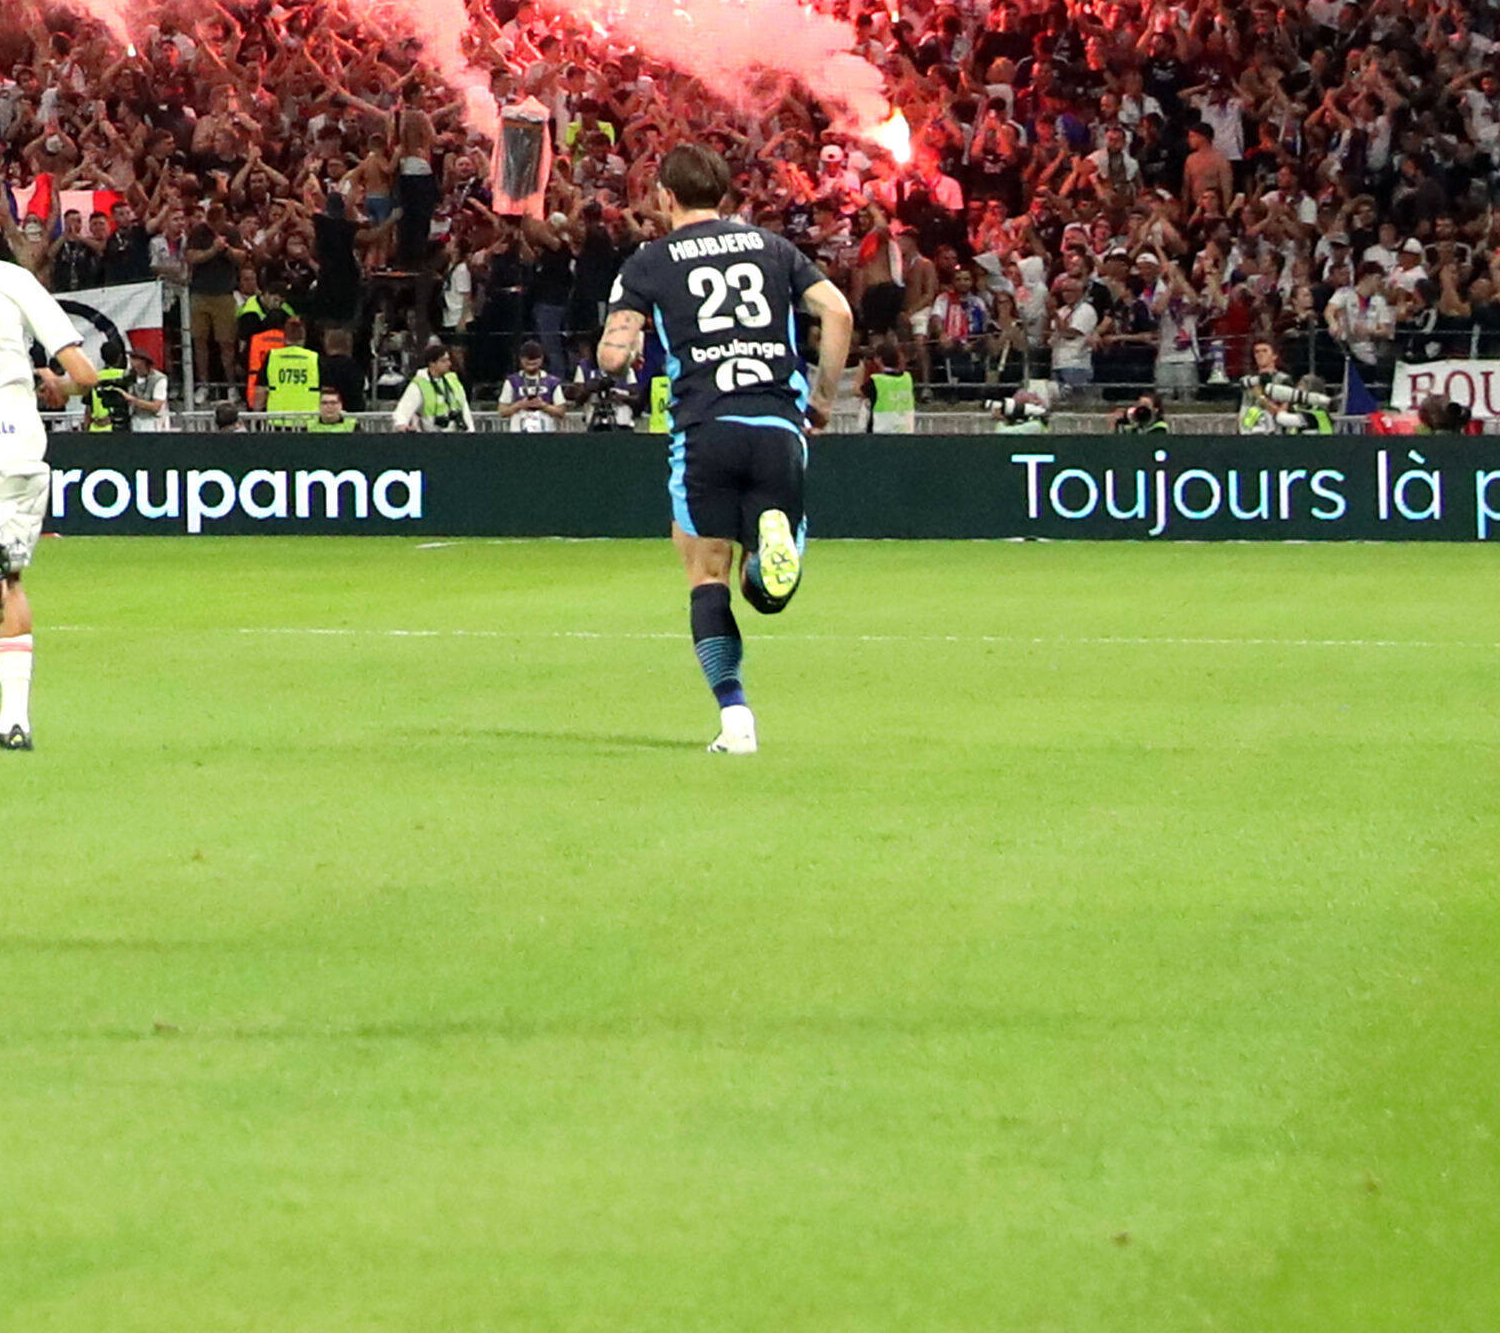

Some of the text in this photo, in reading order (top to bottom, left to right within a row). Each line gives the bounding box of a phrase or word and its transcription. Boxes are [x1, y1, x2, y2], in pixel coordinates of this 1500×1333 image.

[668, 231, 764, 262] HØJBJERG
[688, 263, 772, 333] 23
[278, 368, 308, 384] 0795
[51, 466, 423, 533] roupama
[1011, 450, 1348, 537] Toujours
[1376, 449, 1444, 522] là
